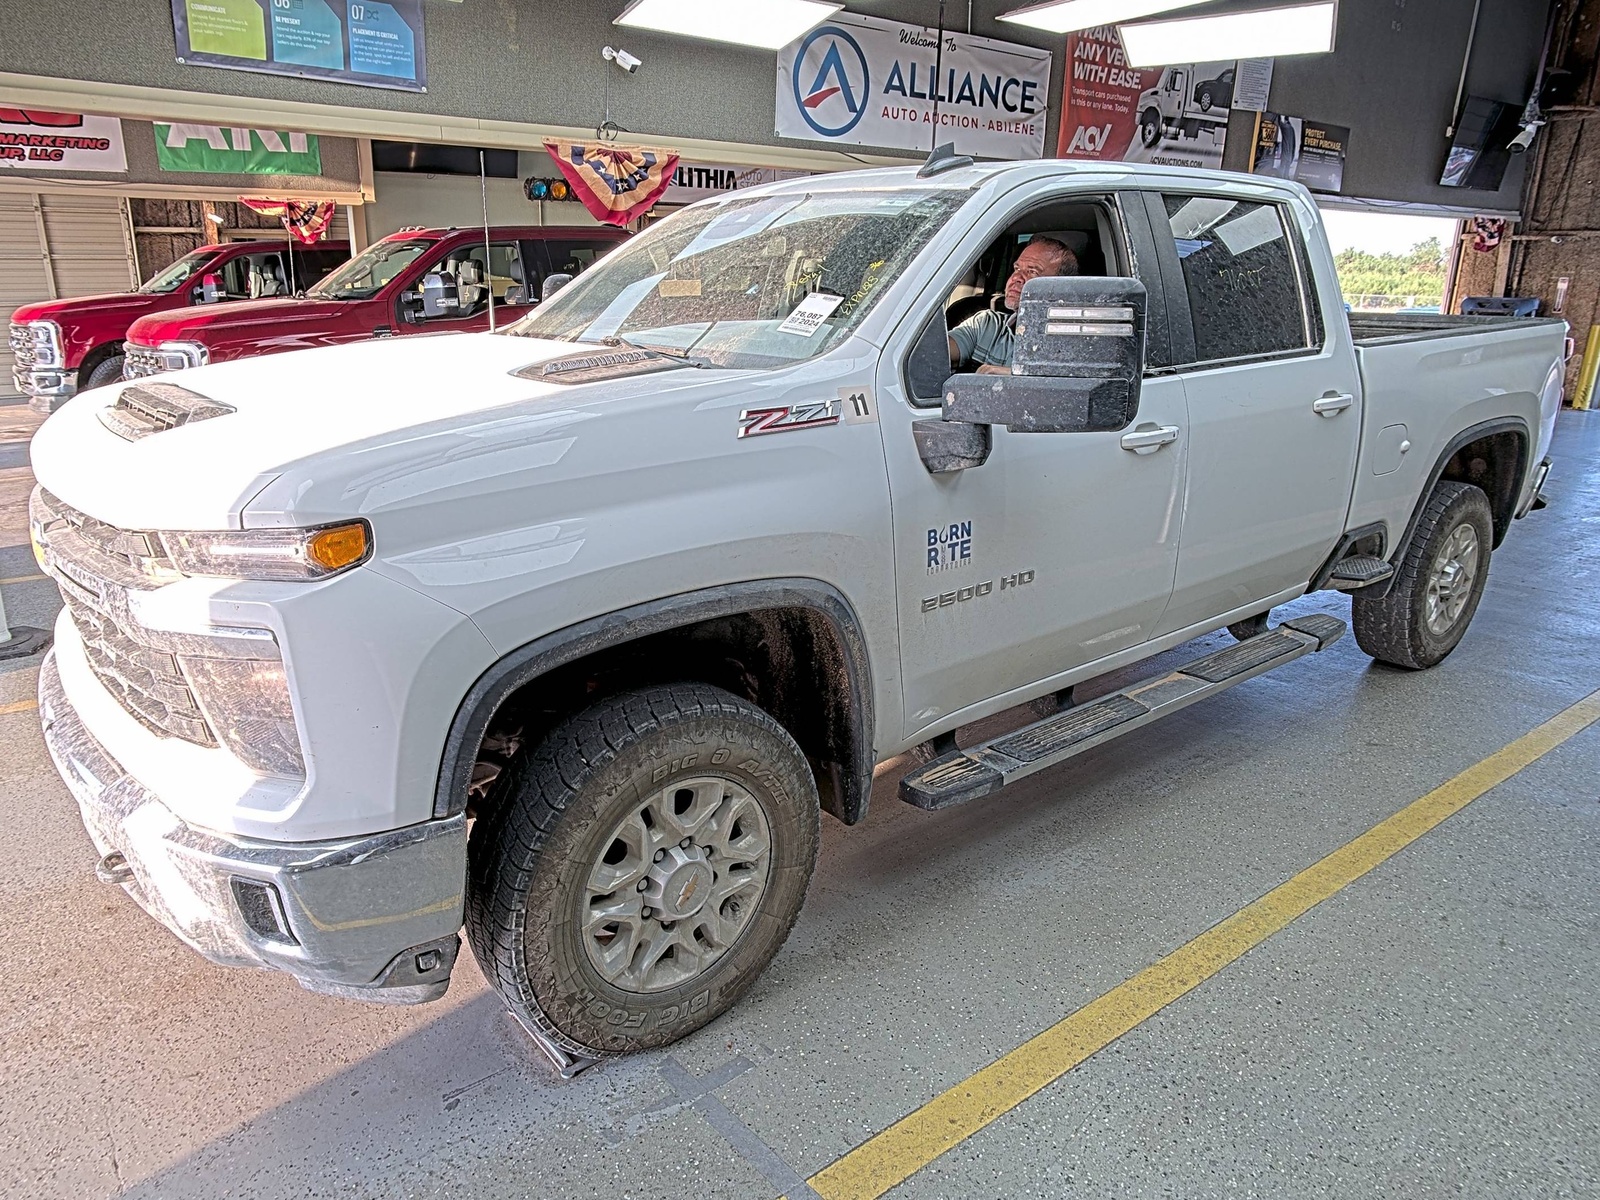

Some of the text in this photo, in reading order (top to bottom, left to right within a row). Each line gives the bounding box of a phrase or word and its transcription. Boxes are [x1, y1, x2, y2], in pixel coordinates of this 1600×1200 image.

[190, 3, 226, 14] COMMUNICATE
[352, 4, 364, 20] 07
[282, 17, 300, 25] PRESENT
[352, 28, 375, 36] PLACEMENT
[945, 38, 956, 51] To
[1074, 41, 1105, 62] ANY
[1074, 61, 1141, 90] WITH EASE.
[883, 60, 1038, 114] ALLIANCE
[1072, 86, 1095, 97] Transport
[1106, 94, 1131, 102] purchased
[1093, 102, 1101, 110] any
[1115, 104, 1129, 114] Today.
[882, 106, 918, 122] AUTO
[923, 112, 979, 130] AUCTION
[988, 116, 1034, 136] ABILENE
[0, 133, 110, 150] MARKETING
[1066, 124, 1112, 153] ACV
[1305, 128, 1326, 139] PROTECT
[1304, 137, 1320, 147] EVERY
[29, 148, 64, 161] LLC
[1150, 156, 1203, 168] ACVAUCTIONS.COM
[678, 166, 737, 190] LITHIA
[740, 171, 762, 181] AUTO
[795, 311, 823, 320] 76,087
[799, 319, 820, 327] 2024
[849, 393, 870, 416] 11
[737, 398, 842, 439] Z71
[921, 569, 1035, 613] 2500 HD
[652, 753, 698, 784] BIG
[711, 748, 731, 764] O
[575, 990, 710, 1028] BIG FOOT
